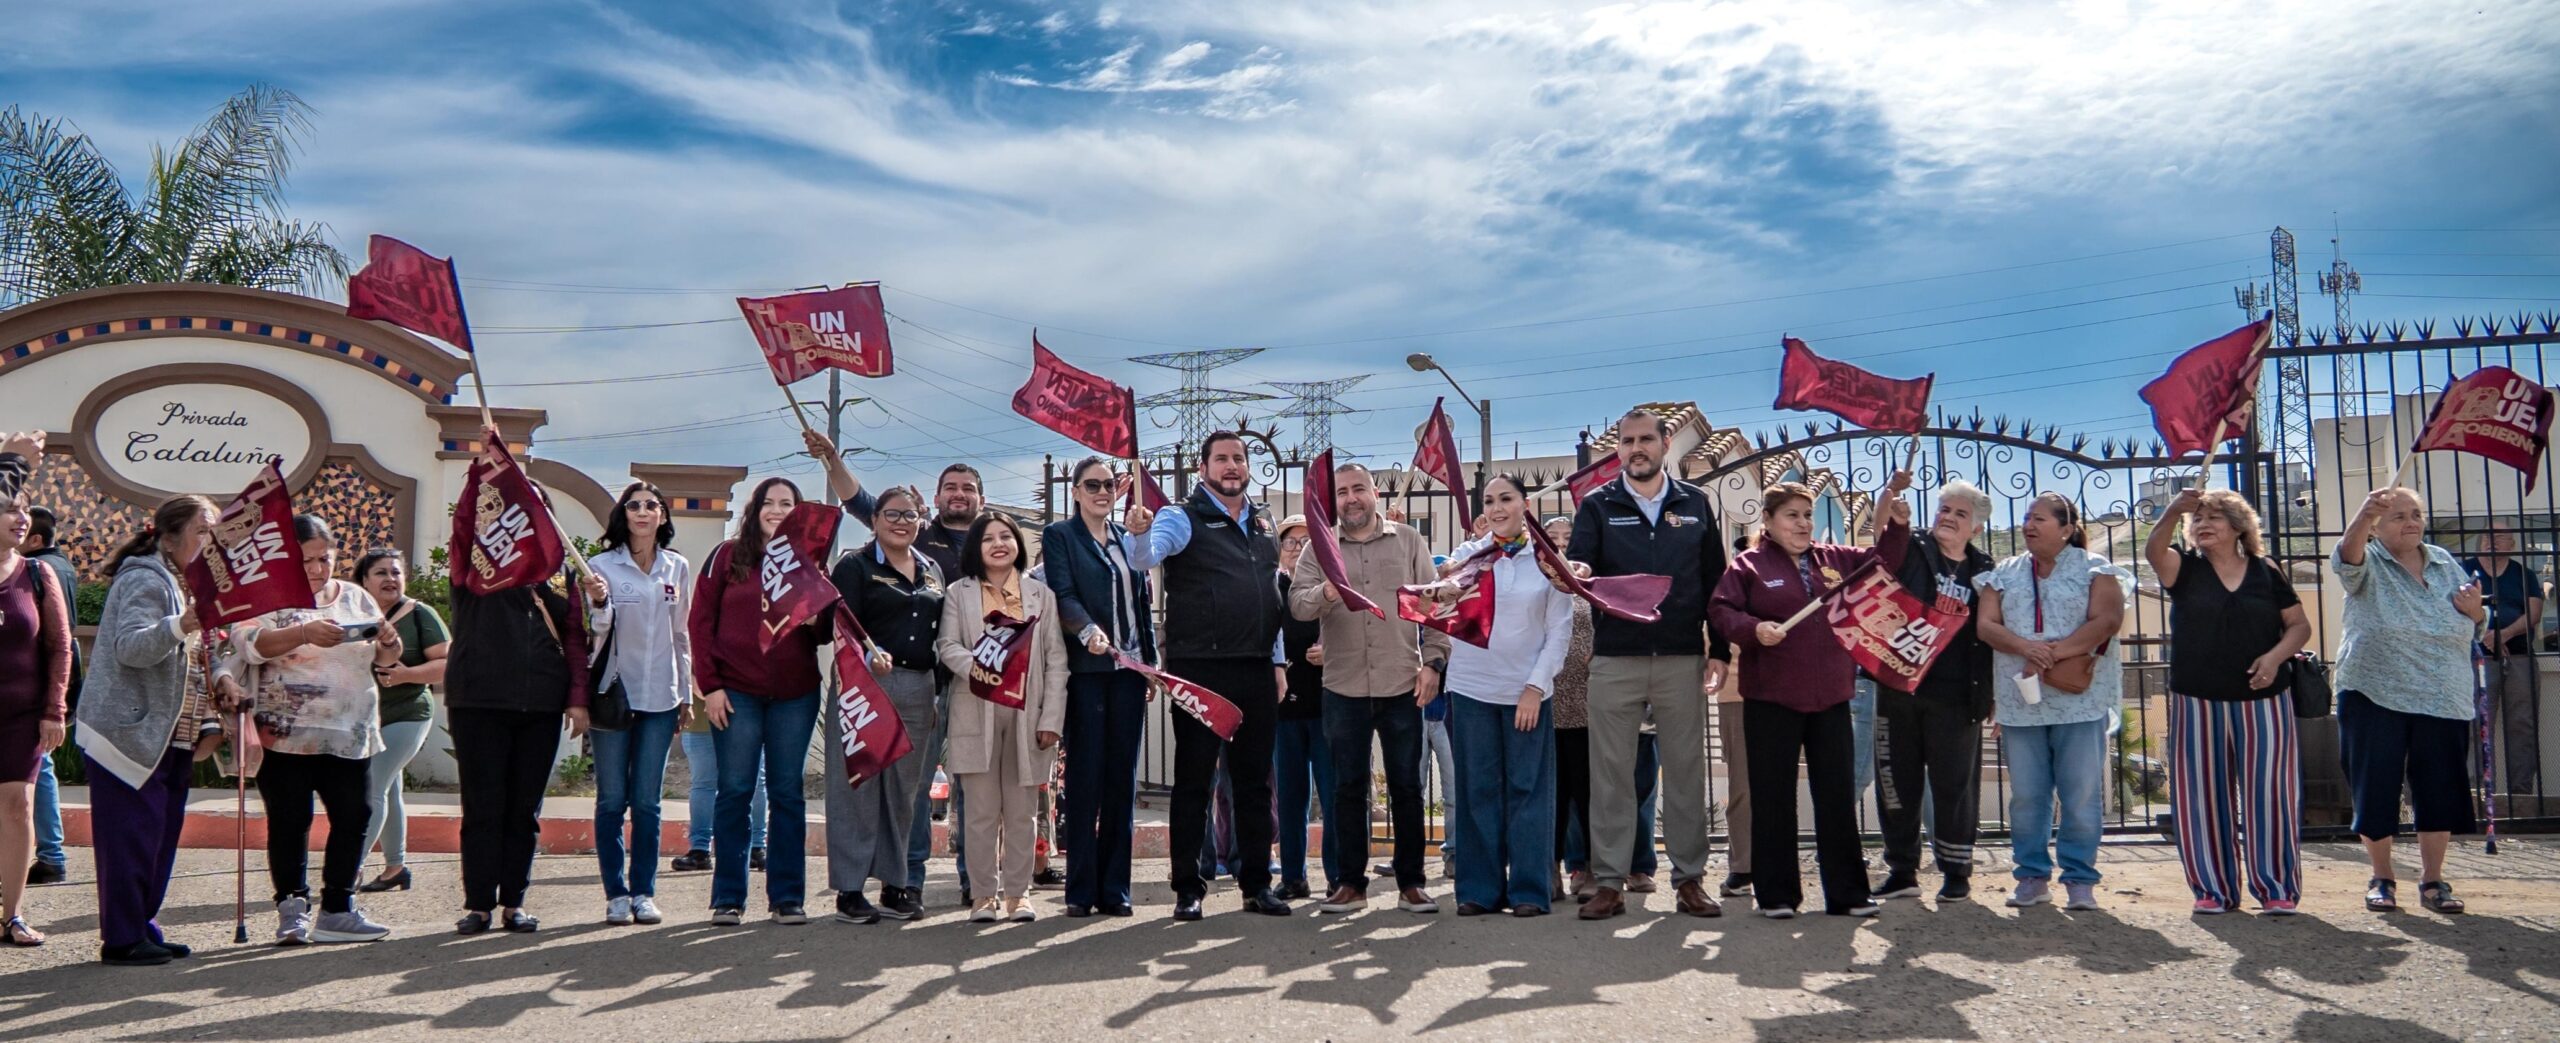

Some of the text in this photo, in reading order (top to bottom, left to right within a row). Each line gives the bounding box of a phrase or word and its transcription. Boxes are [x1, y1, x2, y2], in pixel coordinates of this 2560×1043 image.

[810, 311, 845, 334] UN
[158, 401, 248, 426] Privada
[125, 431, 282, 465] Cataluña
[253, 521, 289, 561] UN
[500, 503, 535, 541] UN
[766, 534, 802, 574] UN
[1907, 617, 1945, 645] UN
[839, 686, 879, 730] UN
[1876, 716, 1890, 760] NEW
